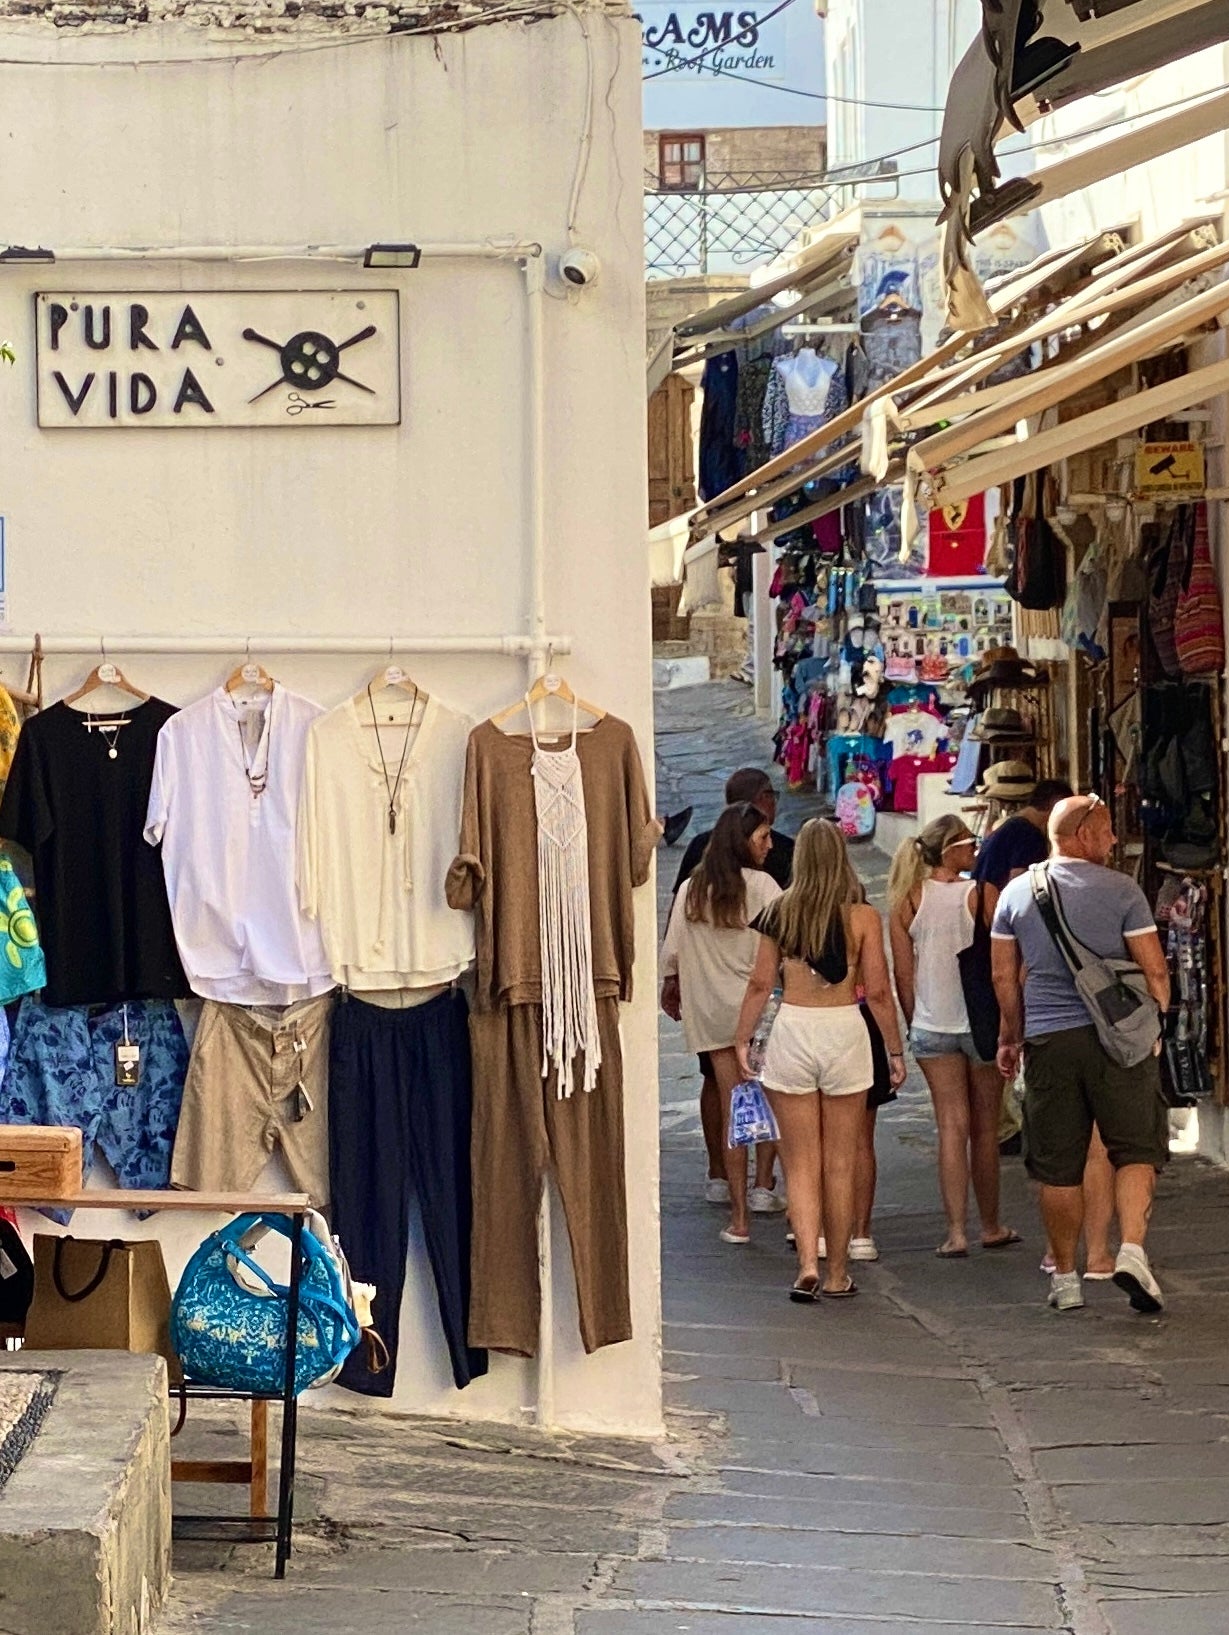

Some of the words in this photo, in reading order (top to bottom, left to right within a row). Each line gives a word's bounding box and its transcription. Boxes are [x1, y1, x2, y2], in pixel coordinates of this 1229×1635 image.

[665, 47, 707, 73] Roof
[712, 48, 776, 76] Garden
[50, 303, 213, 350] PURA
[52, 366, 216, 418] VIDA
